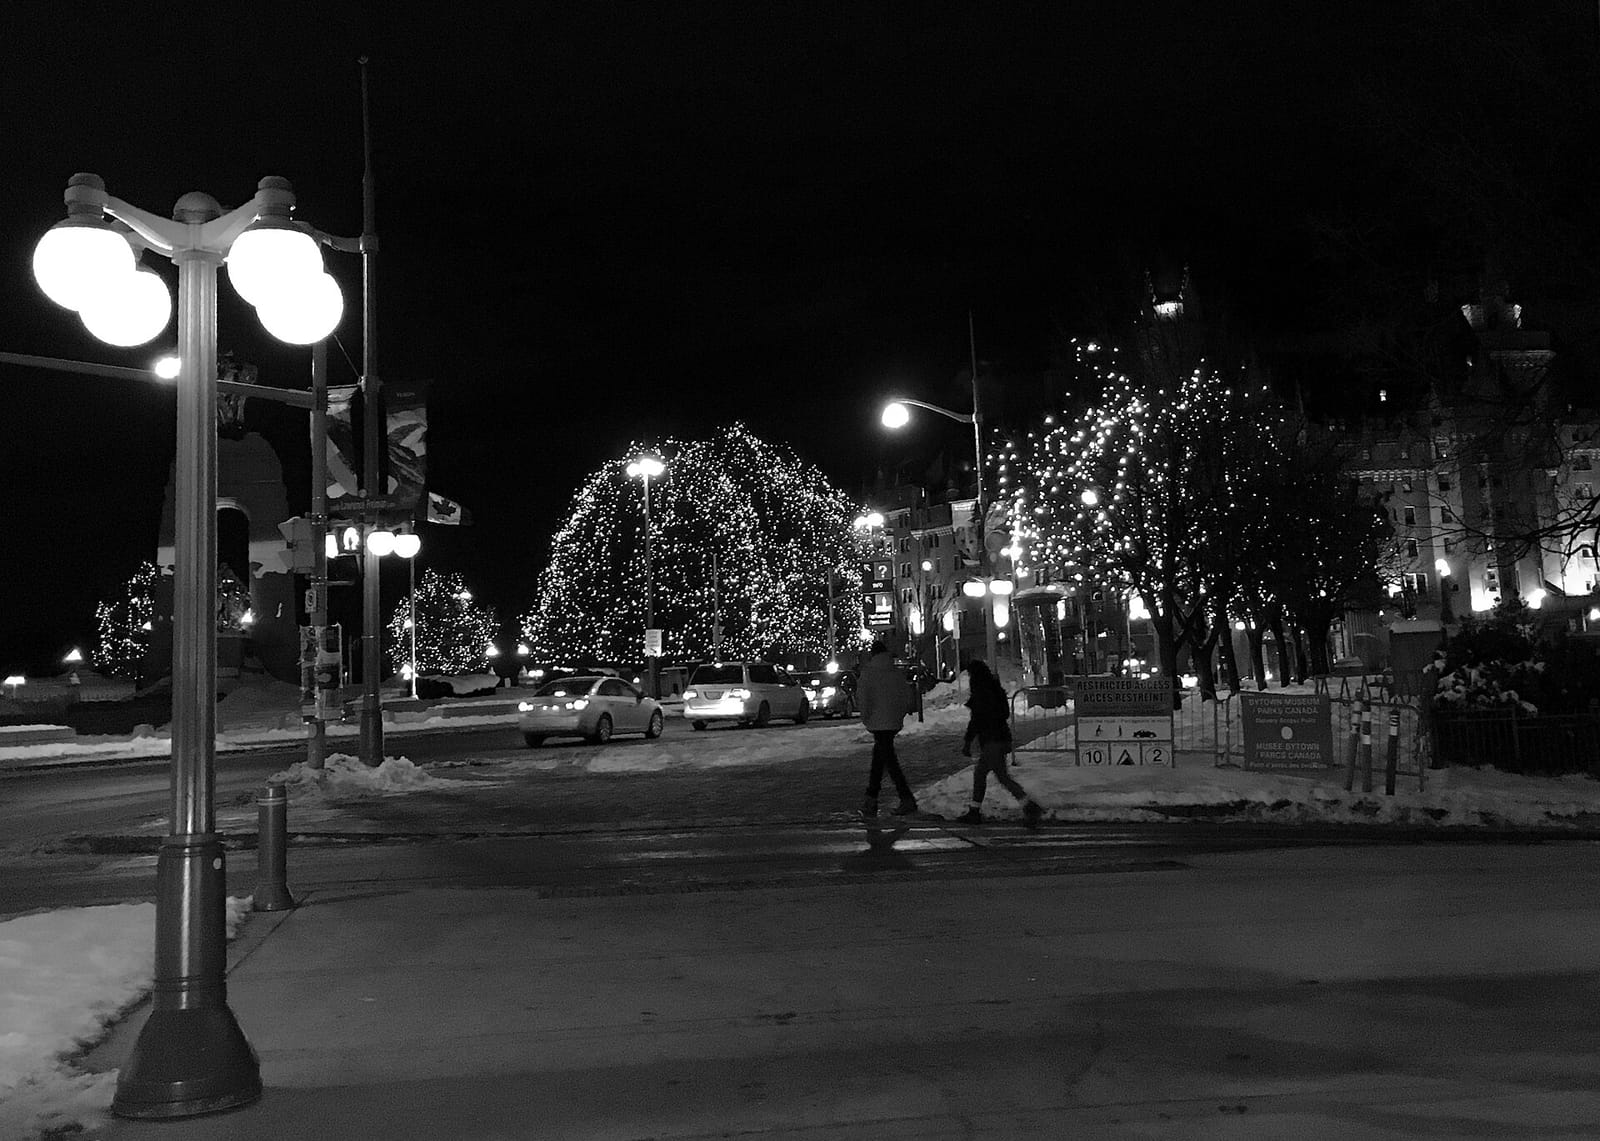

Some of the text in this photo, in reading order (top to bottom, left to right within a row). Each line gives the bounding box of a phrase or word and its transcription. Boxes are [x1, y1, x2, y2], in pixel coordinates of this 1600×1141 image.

[1077, 680, 1170, 690] RESTRICTED ACCESS
[1115, 693, 1164, 702] RESTREINT
[1284, 697, 1320, 706] MUSEUM
[1285, 742, 1320, 751] BYTOWN
[1085, 750, 1102, 764] 10
[1152, 749, 1162, 762] 2
[1288, 752, 1321, 760] CANADA
